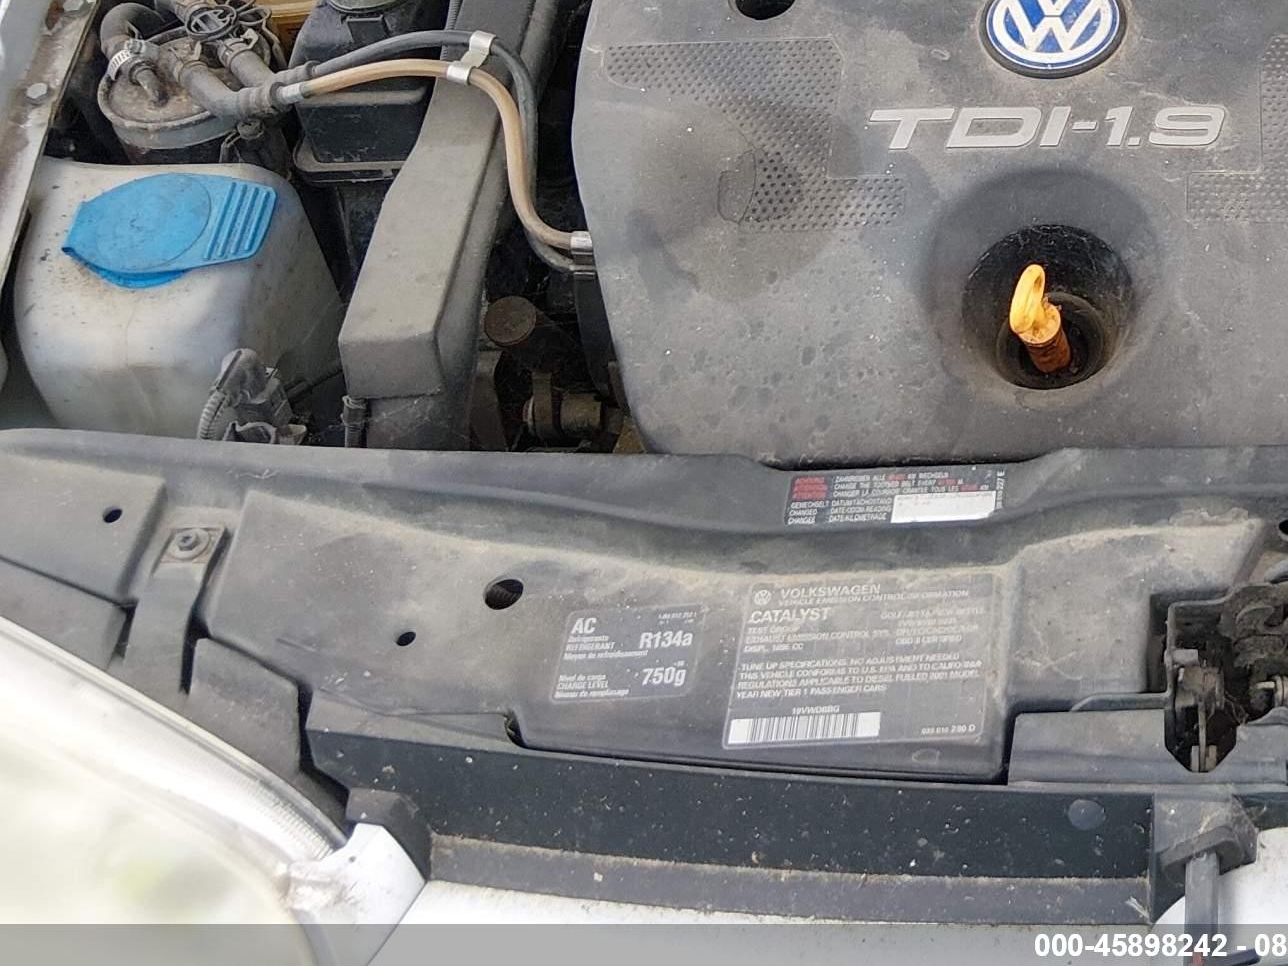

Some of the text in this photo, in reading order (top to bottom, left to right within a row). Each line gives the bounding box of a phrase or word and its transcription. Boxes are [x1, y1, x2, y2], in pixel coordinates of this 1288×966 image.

[868, 105, 1226, 151] TDI-1.9
[779, 584, 881, 600] VOLKSWAGEN
[749, 607, 832, 624] CATALYST
[570, 617, 597, 635] AC
[638, 630, 694, 650] R134a
[739, 672, 759, 680] THIS
[760, 670, 795, 679] VEHICLE
[796, 667, 847, 678] CONFORMS
[848, 666, 860, 675] TO
[919, 662, 931, 672] TO
[766, 661, 778, 670] UP
[850, 657, 864, 666] NO
[557, 680, 609, 690] CHARGE LEVEL
[642, 666, 687, 688] 750g
[737, 679, 798, 690] REGULATIONS
[799, 676, 851, 687] APPLICABLE
[851, 675, 864, 684] TO
[737, 690, 760, 699] YEAR
[760, 689, 782, 698] NEW
[783, 687, 802, 697] TIER
[809, 685, 863, 696] PASSENGER
